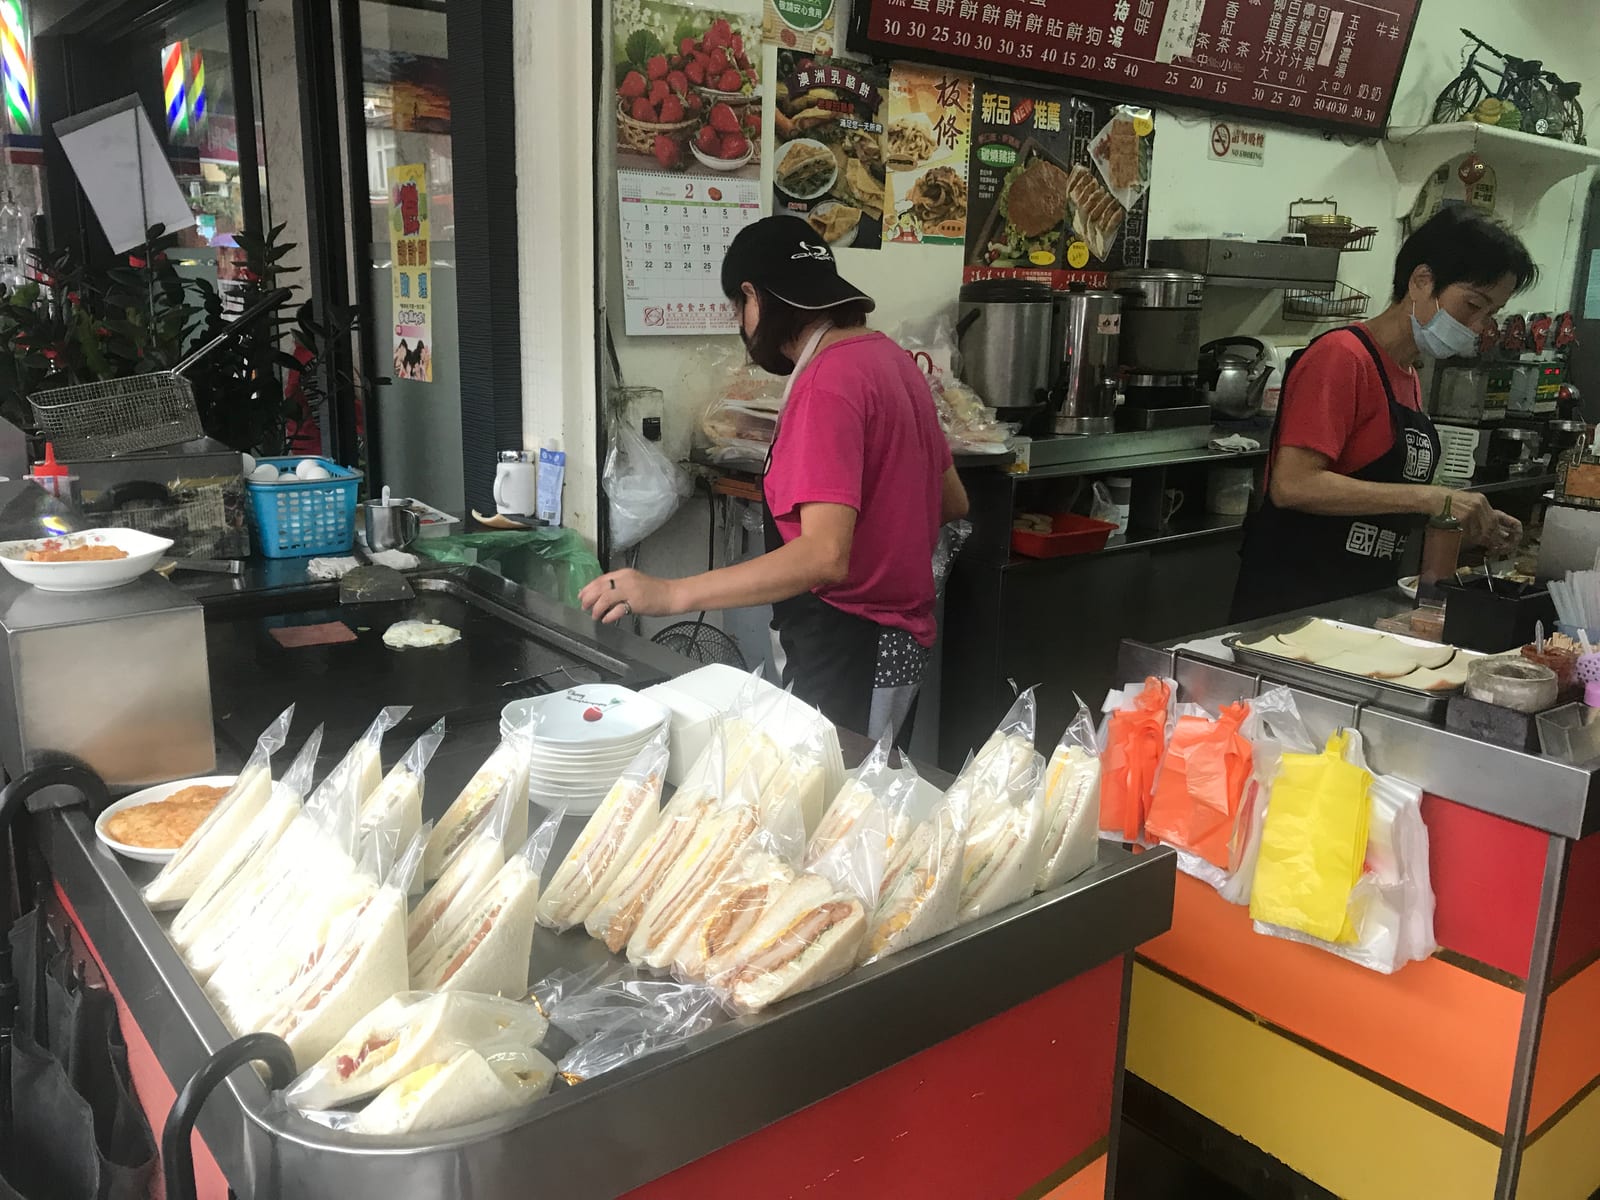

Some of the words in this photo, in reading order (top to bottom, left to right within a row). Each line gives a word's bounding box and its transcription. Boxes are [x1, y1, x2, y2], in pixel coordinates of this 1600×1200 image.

[960, 0, 979, 21] 餅
[981, 3, 1001, 26] 餅
[1004, 8, 1022, 30] 餅
[1025, 13, 1043, 34] 餅
[1045, 18, 1063, 38] 貼
[1066, 22, 1083, 42] 餅
[1107, 0, 1130, 48] 梅湯
[1085, 26, 1103, 46] 狗
[1195, 32, 1211, 50] 茶
[1303, 6, 1331, 71] 可口可樂
[1334, 14, 1361, 79] 玉米濃湯
[884, 18, 900, 36] 30
[907, 21, 926, 39] 30
[931, 26, 950, 42] 25
[953, 31, 971, 47] 30
[974, 35, 992, 51] 30
[997, 39, 1014, 55] 30
[1017, 44, 1033, 59] 35
[1040, 48, 1057, 62] 40
[1062, 51, 1076, 66] 15
[1080, 55, 1096, 69] 20
[1103, 56, 1117, 70] 35
[1124, 63, 1138, 78] 40
[1236, 41, 1251, 58] 茶
[1197, 53, 1209, 67] 中
[1220, 58, 1231, 72] 小
[798, 69, 871, 98] 澳洲乳酪餅
[1165, 71, 1179, 85] 25
[1190, 76, 1203, 90] 20
[1215, 81, 1227, 95] 15
[1258, 66, 1269, 80] 大
[1278, 70, 1288, 83] 中
[1296, 73, 1305, 87] 小
[1318, 78, 1329, 92] 大
[1331, 80, 1341, 93] 中
[1343, 83, 1352, 96] 小
[1252, 88, 1264, 101] 30
[1271, 91, 1283, 104] 25
[1289, 95, 1301, 108] 20
[1313, 98, 1325, 111] 50
[1326, 101, 1337, 113] 40
[1336, 102, 1348, 115] 30
[933, 76, 965, 150] 板條
[981, 92, 1011, 126] 新品
[1033, 100, 1061, 132] 推薦
[1013, 100, 1032, 124] NEW
[1352, 106, 1363, 119] 30
[1365, 109, 1376, 122] 30
[684, 183, 694, 199] 2
[1346, 521, 1396, 560] 國農
